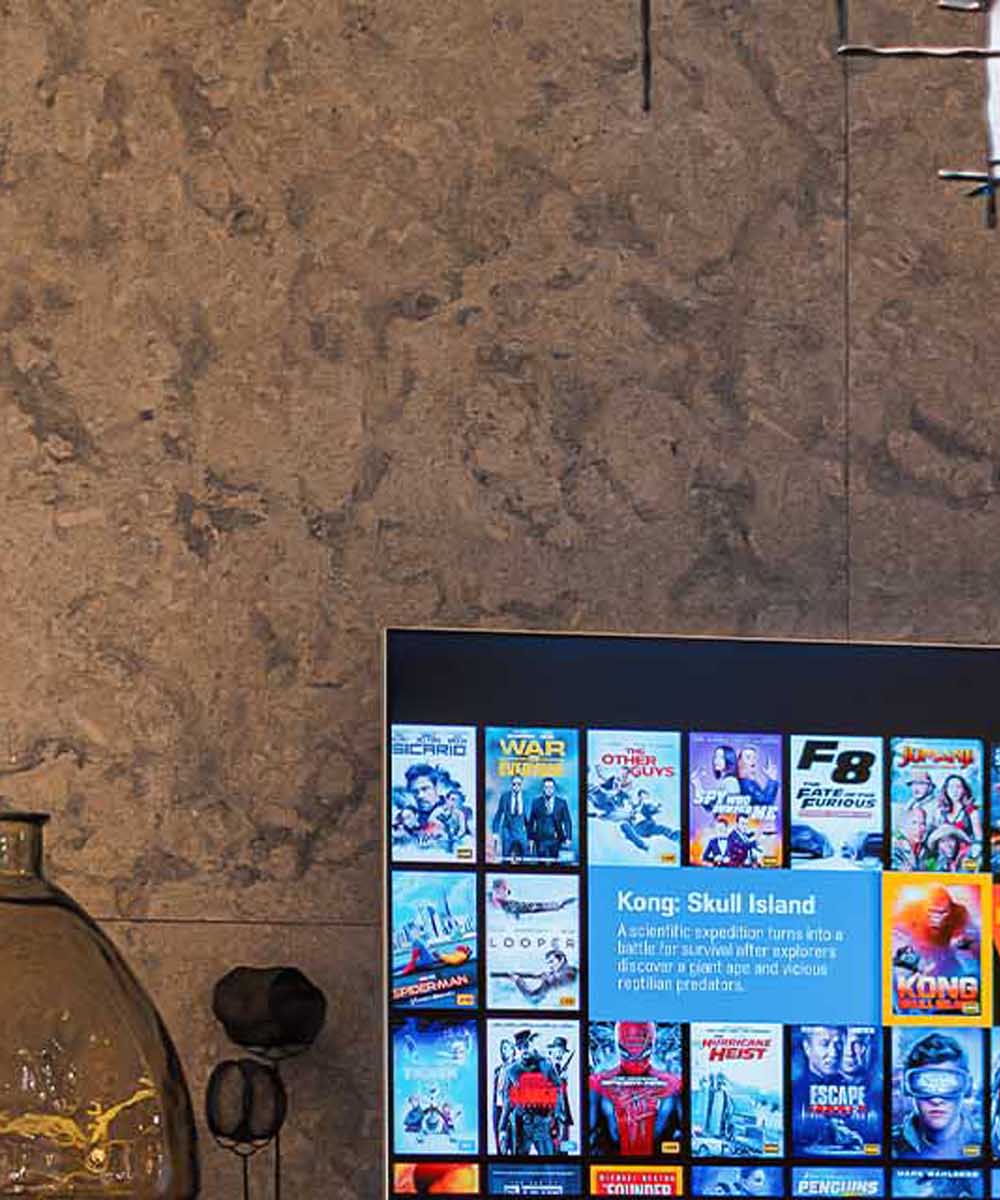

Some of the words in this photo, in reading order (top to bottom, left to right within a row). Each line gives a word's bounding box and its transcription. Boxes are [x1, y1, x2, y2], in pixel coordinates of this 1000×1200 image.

[392, 744, 466, 756] SICARIO
[500, 739, 566, 757] WAR
[601, 754, 657, 765] OTHER
[797, 741, 876, 785] F8
[631, 766, 675, 777] GUYS
[797, 788, 843, 799] FATE
[802, 798, 876, 809] FURIOUS
[618, 891, 681, 917] Kong:
[688, 892, 741, 913] Skull
[749, 893, 816, 914] Island
[618, 922, 627, 937] A
[628, 923, 691, 938] scientific
[695, 925, 764, 944] expedition
[768, 926, 805, 941] turns
[807, 927, 833, 942] into
[836, 931, 844, 942] a
[491, 937, 576, 949] LOOPER
[618, 939, 656, 955] battle
[659, 940, 679, 956] for
[682, 943, 734, 957] survival
[736, 944, 768, 957] after
[772, 945, 837, 961] explorers
[618, 958, 673, 973] discover
[677, 963, 686, 973] a
[689, 961, 722, 978] giant
[727, 963, 751, 977] ape
[755, 962, 779, 976] and
[783, 963, 828, 976] vicious
[618, 976, 673, 995] reptilian
[897, 974, 978, 1001] KONG
[702, 1039, 772, 1048] HURRICANE
[709, 1047, 767, 1061] HEIST
[810, 1085, 866, 1105] ESCAPE
[798, 1180, 879, 1194] PENGUINS
